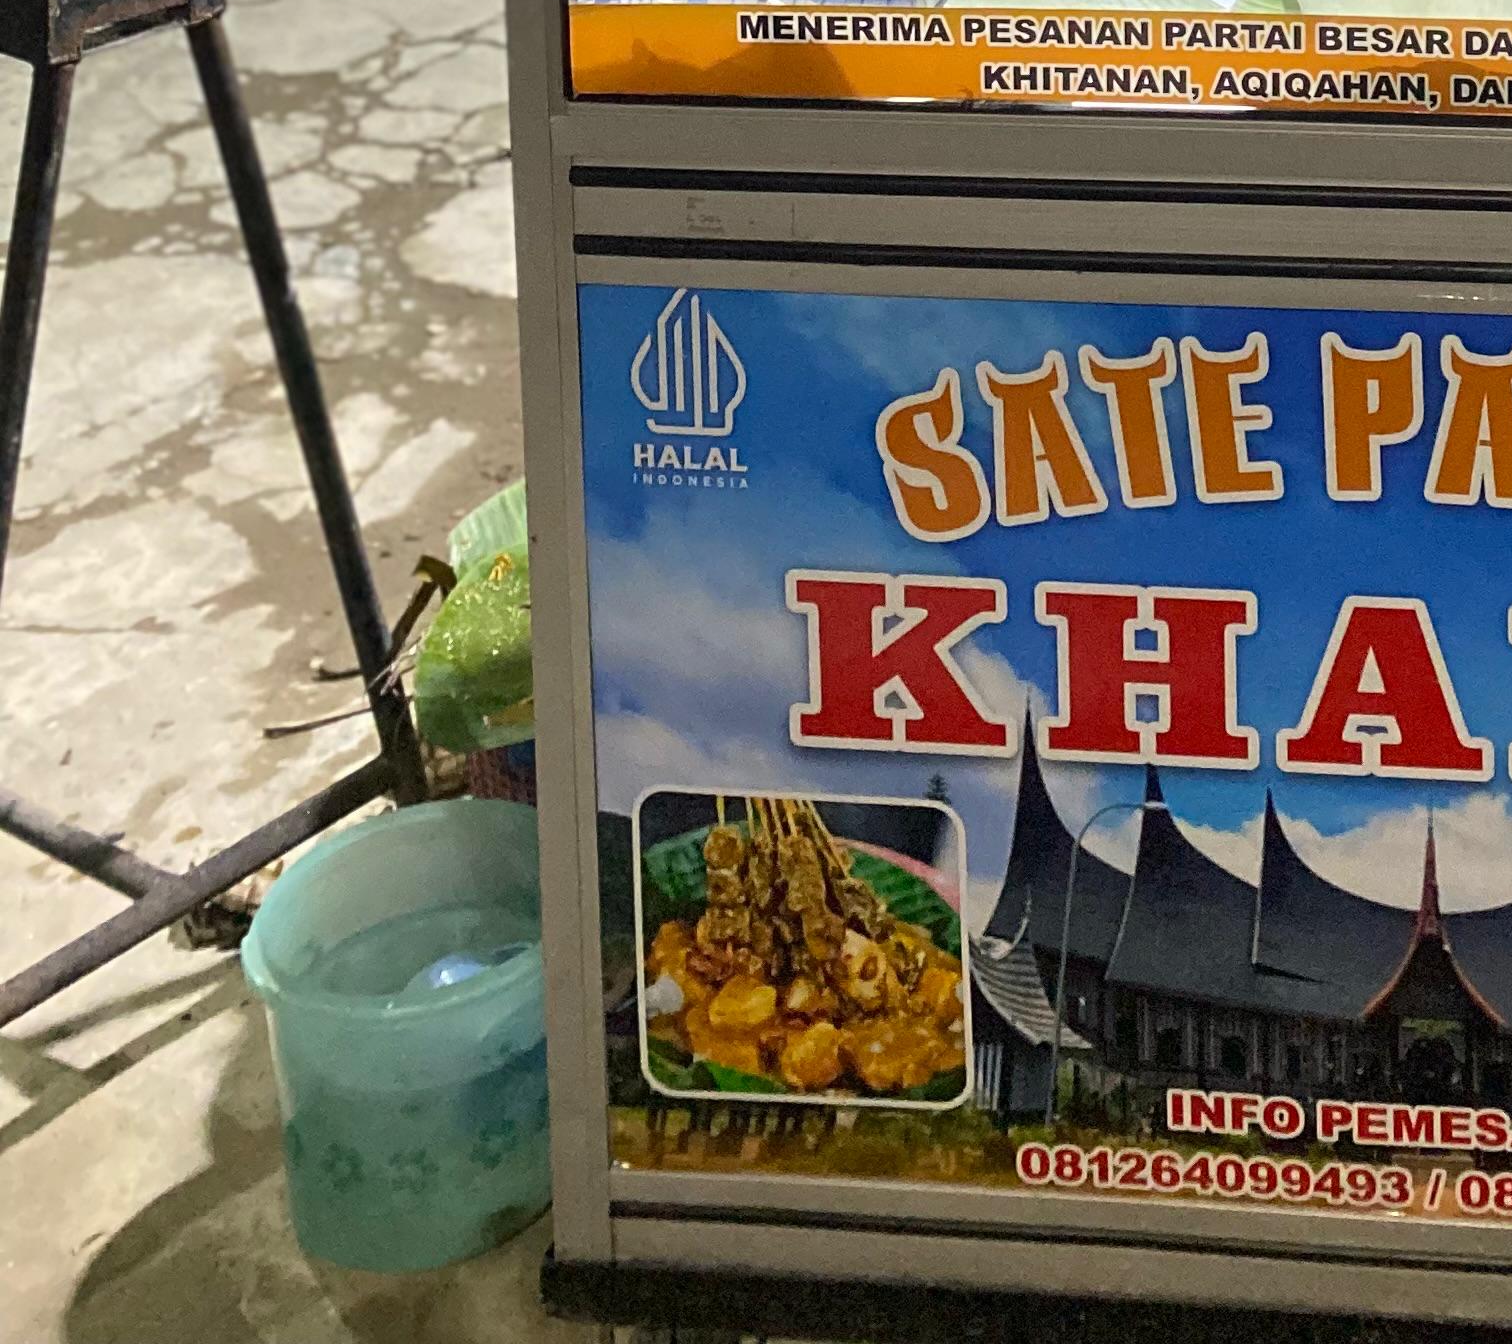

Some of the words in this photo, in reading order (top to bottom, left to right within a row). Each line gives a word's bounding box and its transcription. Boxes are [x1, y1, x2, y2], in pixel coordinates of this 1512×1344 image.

[736, 11, 954, 46] MENERIMA
[961, 16, 1152, 49] PESANAN
[1162, 19, 1304, 54] PARTAI
[1315, 24, 1451, 58] BESAR
[981, 62, 1201, 103] KHITANAN,
[1210, 67, 1442, 112] AQIQAHAN,
[633, 442, 749, 473] HALAL
[875, 331, 1284, 542] SATE
[632, 473, 749, 490] INDONESIA
[1167, 1088, 1304, 1139] INFO
[1016, 1142, 1414, 1209] 081264099493
[1424, 1167, 1447, 1212] /
